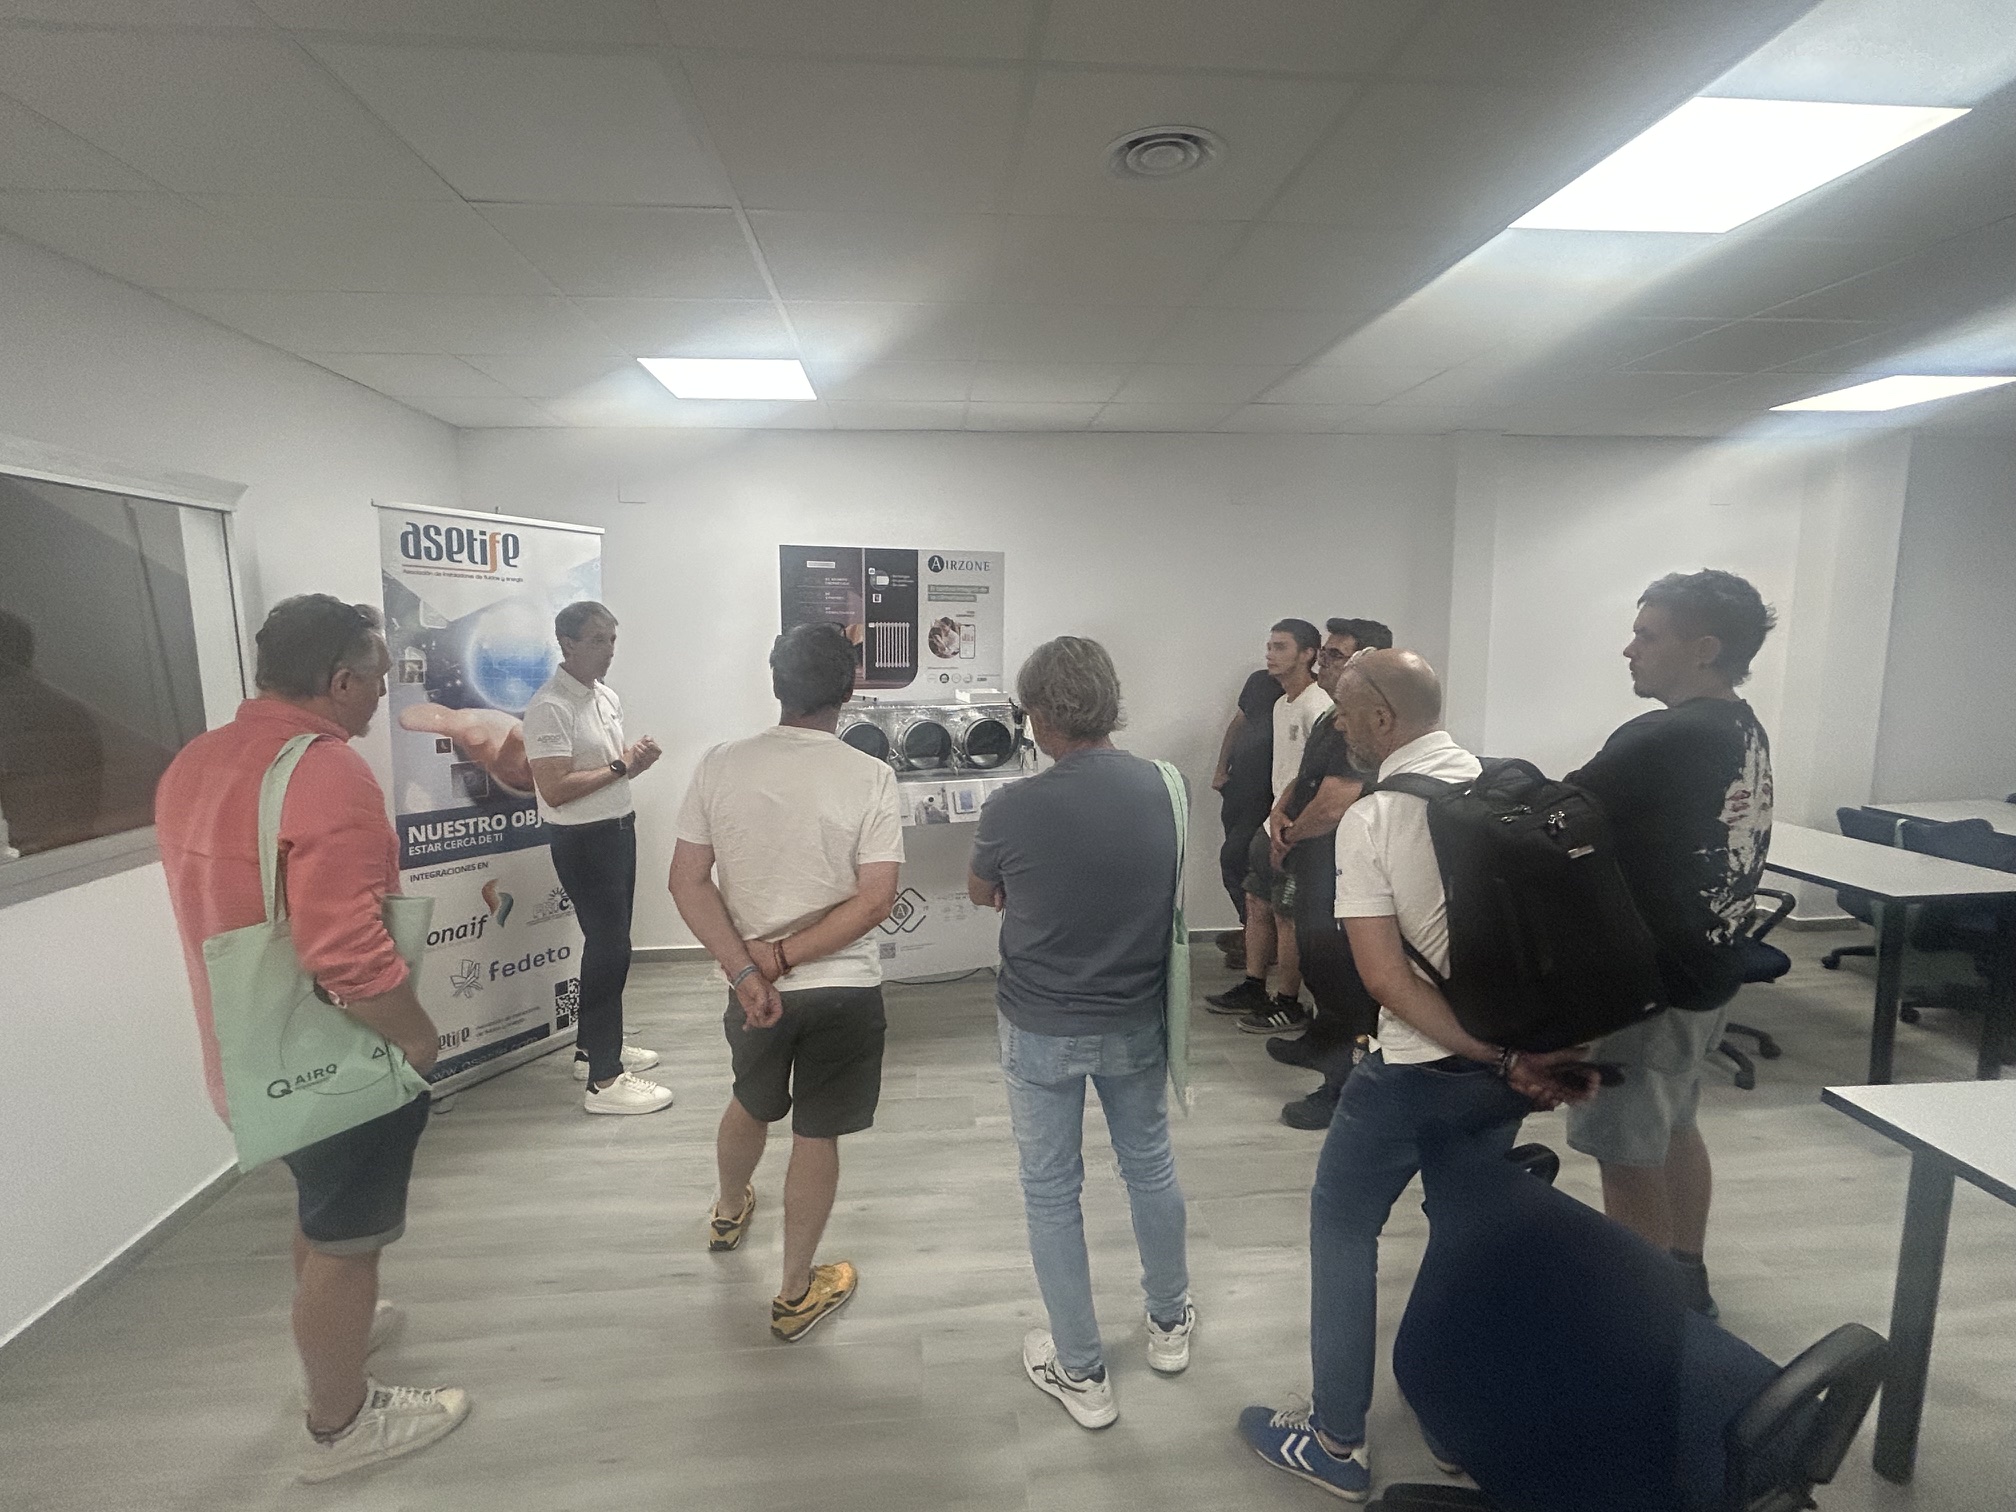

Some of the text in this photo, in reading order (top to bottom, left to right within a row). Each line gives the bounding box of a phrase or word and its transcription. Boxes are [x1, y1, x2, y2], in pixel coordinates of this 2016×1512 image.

[400, 521, 520, 573] asetife
[928, 554, 991, 573] AIRZONE
[408, 809, 543, 843] NUESTRO OBJ
[408, 832, 503, 856] ESTAR CERCA DE TI
[410, 862, 489, 882] INTEGRACIONES EN
[426, 914, 489, 946] onaif
[489, 945, 571, 981] fedeto
[438, 1026, 470, 1050] etife
[295, 1063, 338, 1085] AIRQ
